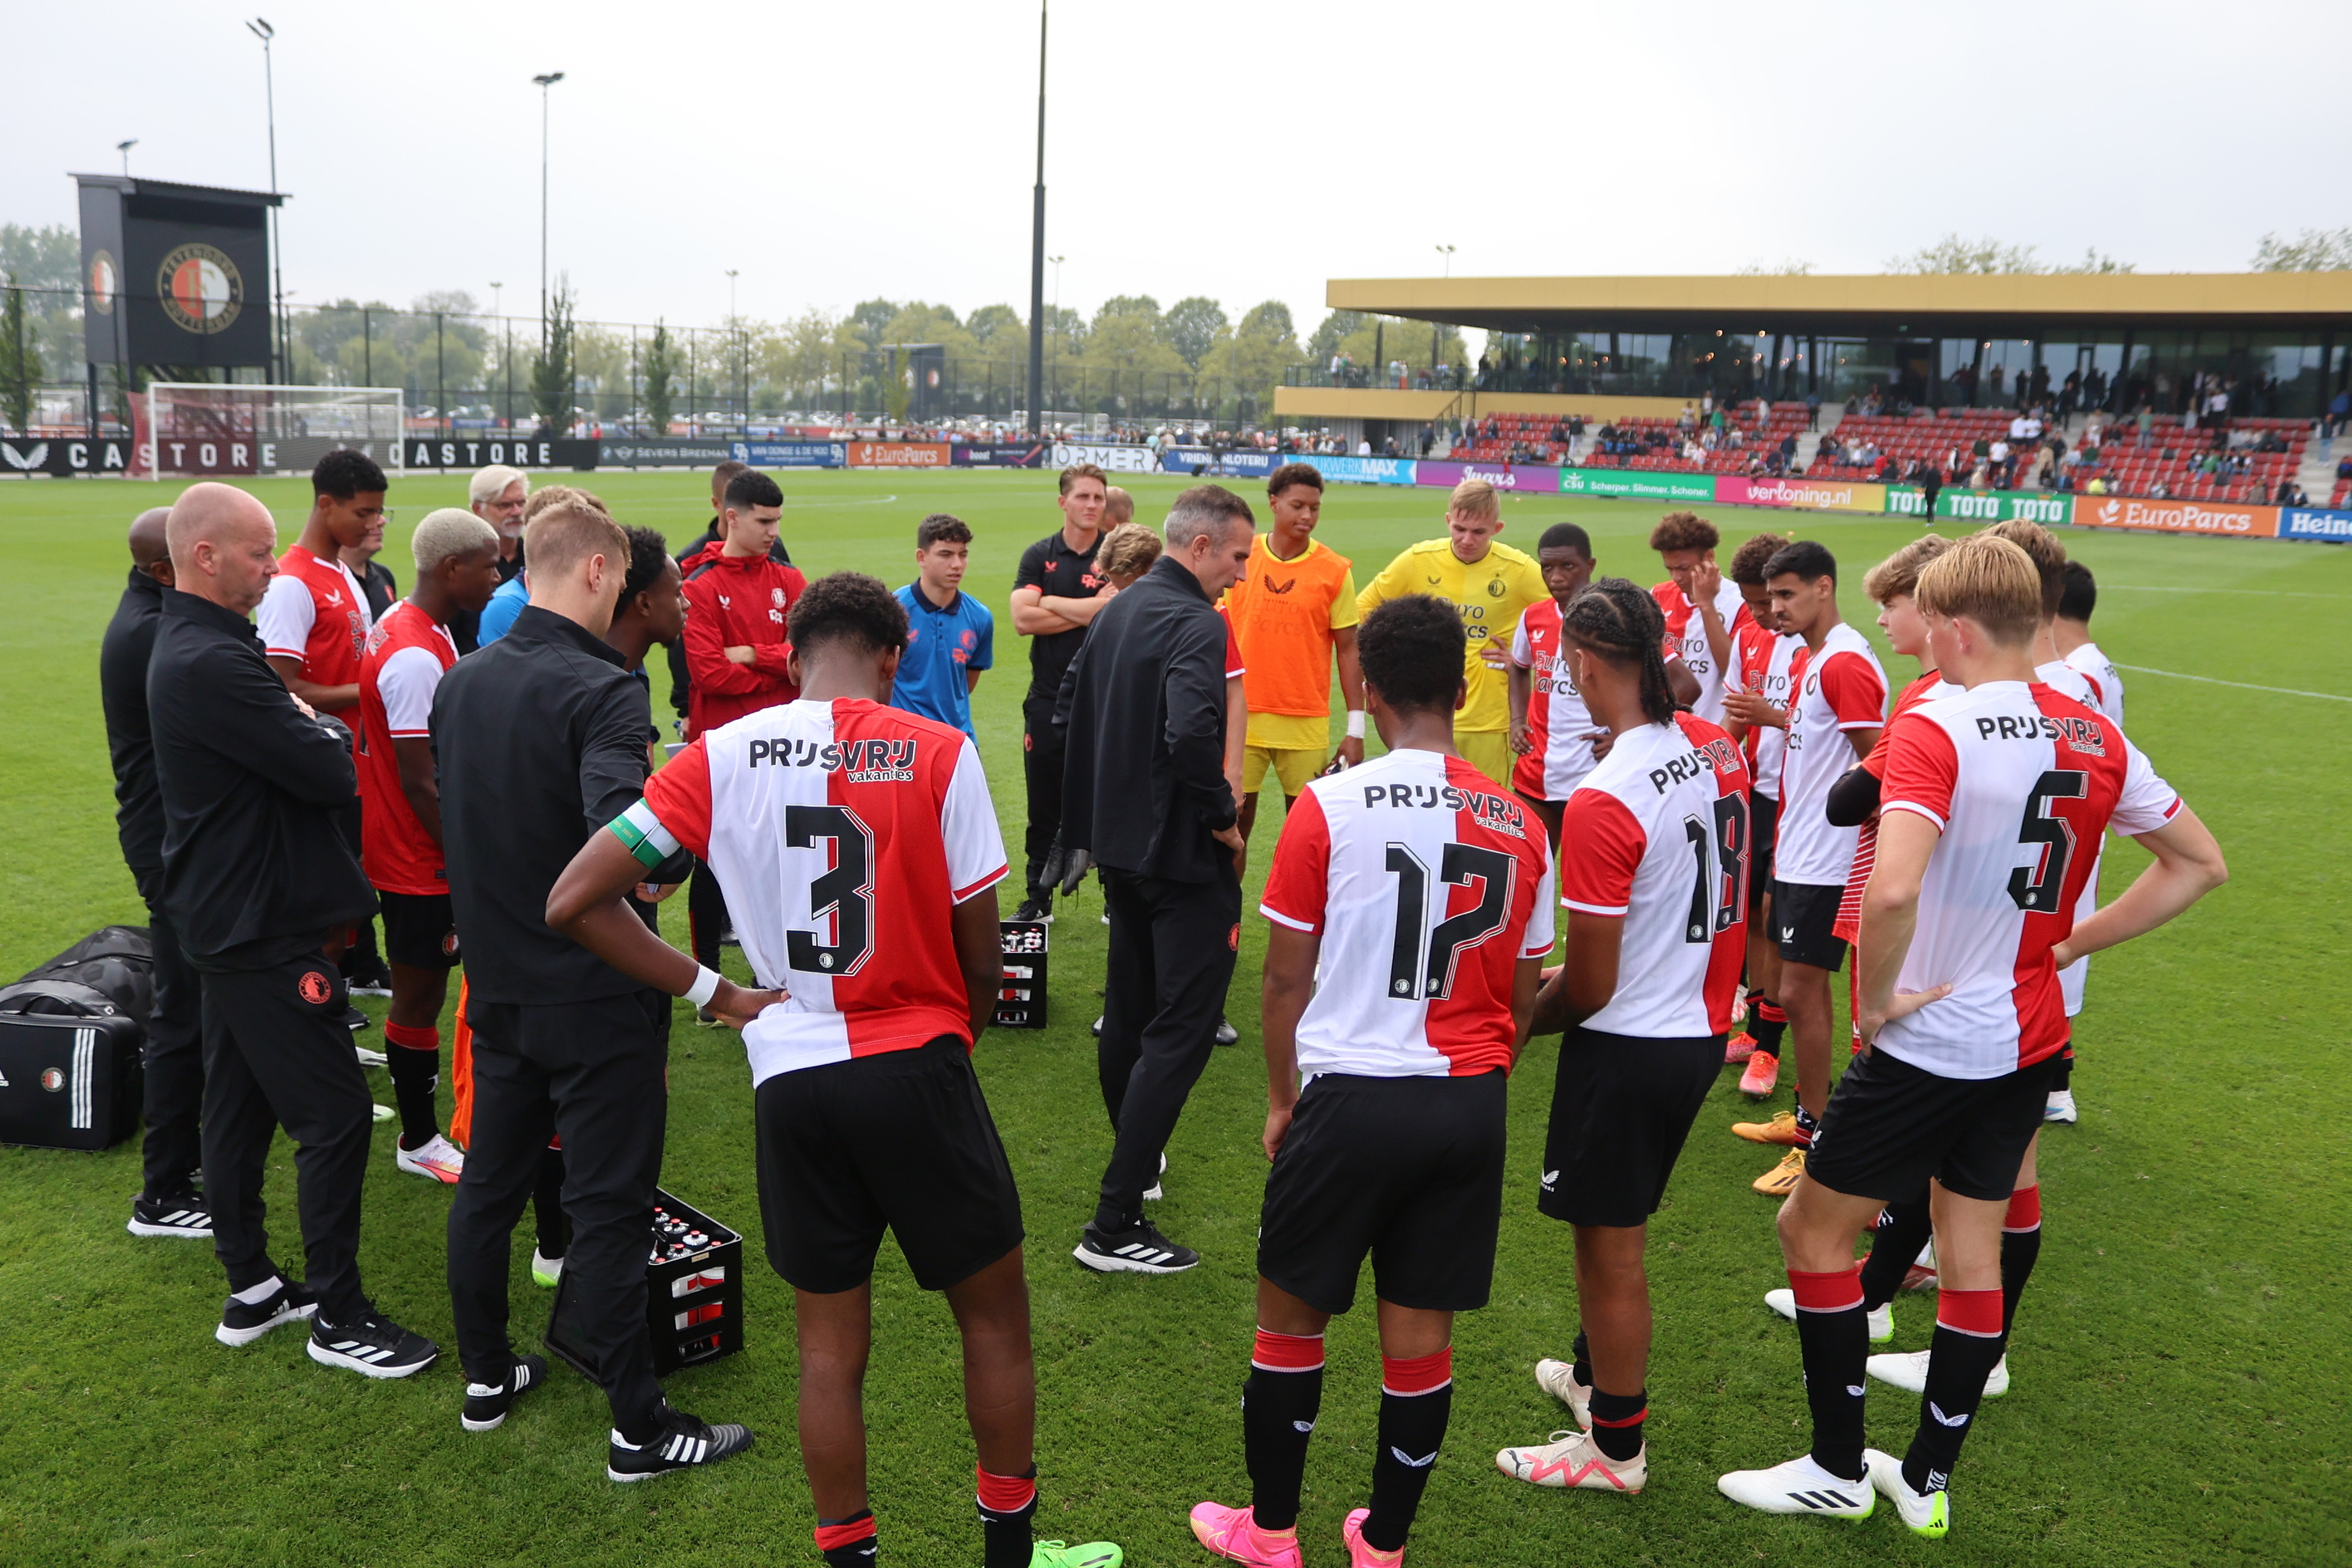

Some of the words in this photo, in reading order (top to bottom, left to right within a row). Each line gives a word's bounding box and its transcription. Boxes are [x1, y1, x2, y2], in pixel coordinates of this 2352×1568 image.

[68, 443, 276, 467] CASTORE
[382, 442, 551, 466] CASTORE
[875, 446, 938, 463] EuroParcs
[1057, 446, 1145, 469] ORMER
[1179, 452, 1269, 468] VRIENNLOTERIJ
[1563, 480, 1584, 489] CSU
[1591, 481, 1631, 493] Scherper.
[1633, 483, 1670, 494] Slimmer.
[1671, 486, 1710, 497] Schoner.
[1746, 481, 1852, 508] verloning.nl
[1950, 494, 2000, 518] TOTO
[2013, 498, 2065, 523] TOTO
[2125, 503, 2252, 531] EuroParcs
[1537, 671, 1579, 696] arcs
[1750, 670, 1786, 690] Euro
[2068, 740, 2106, 758] vakanties
[847, 768, 914, 783] vakanties
[1474, 815, 1527, 840] vakanties
[2006, 770, 2089, 915] 5
[1683, 790, 1750, 944] 18
[785, 804, 875, 977] 3
[1385, 841, 1518, 1001] 17
